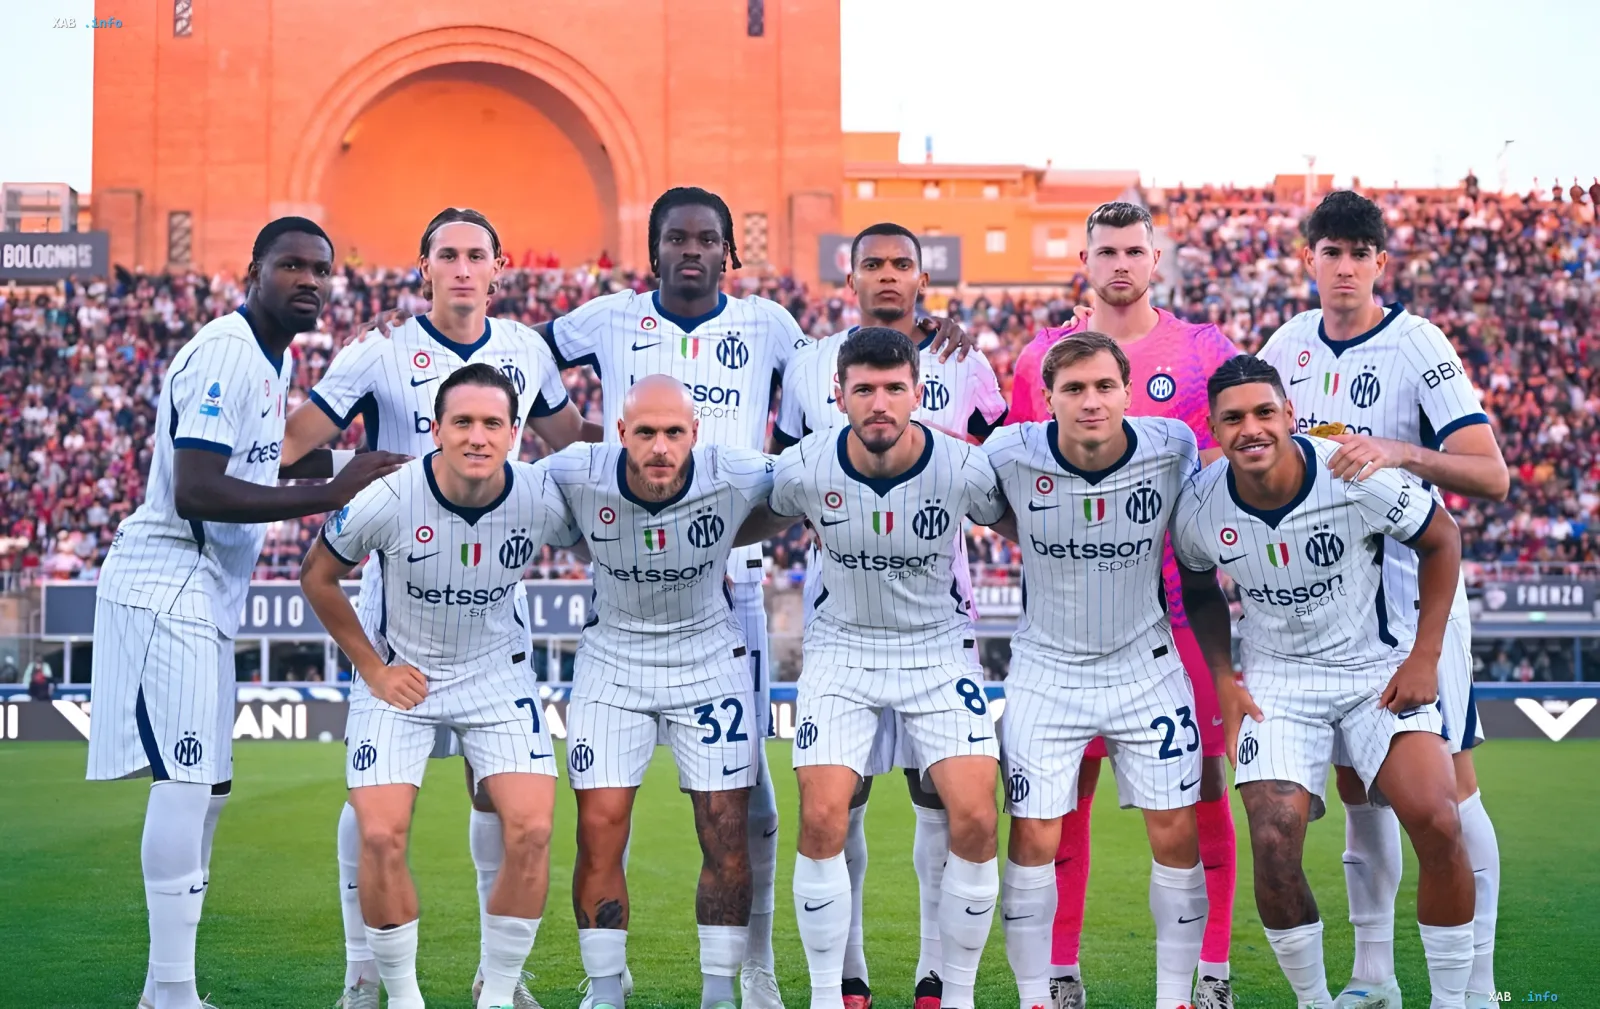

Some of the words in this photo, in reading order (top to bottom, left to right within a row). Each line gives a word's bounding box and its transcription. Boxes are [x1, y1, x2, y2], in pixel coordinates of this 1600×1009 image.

[3, 243, 78, 269] BOLOGNA
[825, 543, 938, 572] betsson
[1030, 534, 1153, 560] betsson
[515, 697, 540, 734] 7
[956, 678, 987, 716] 8
[694, 697, 748, 744] 32
[1150, 705, 1200, 760] 23
